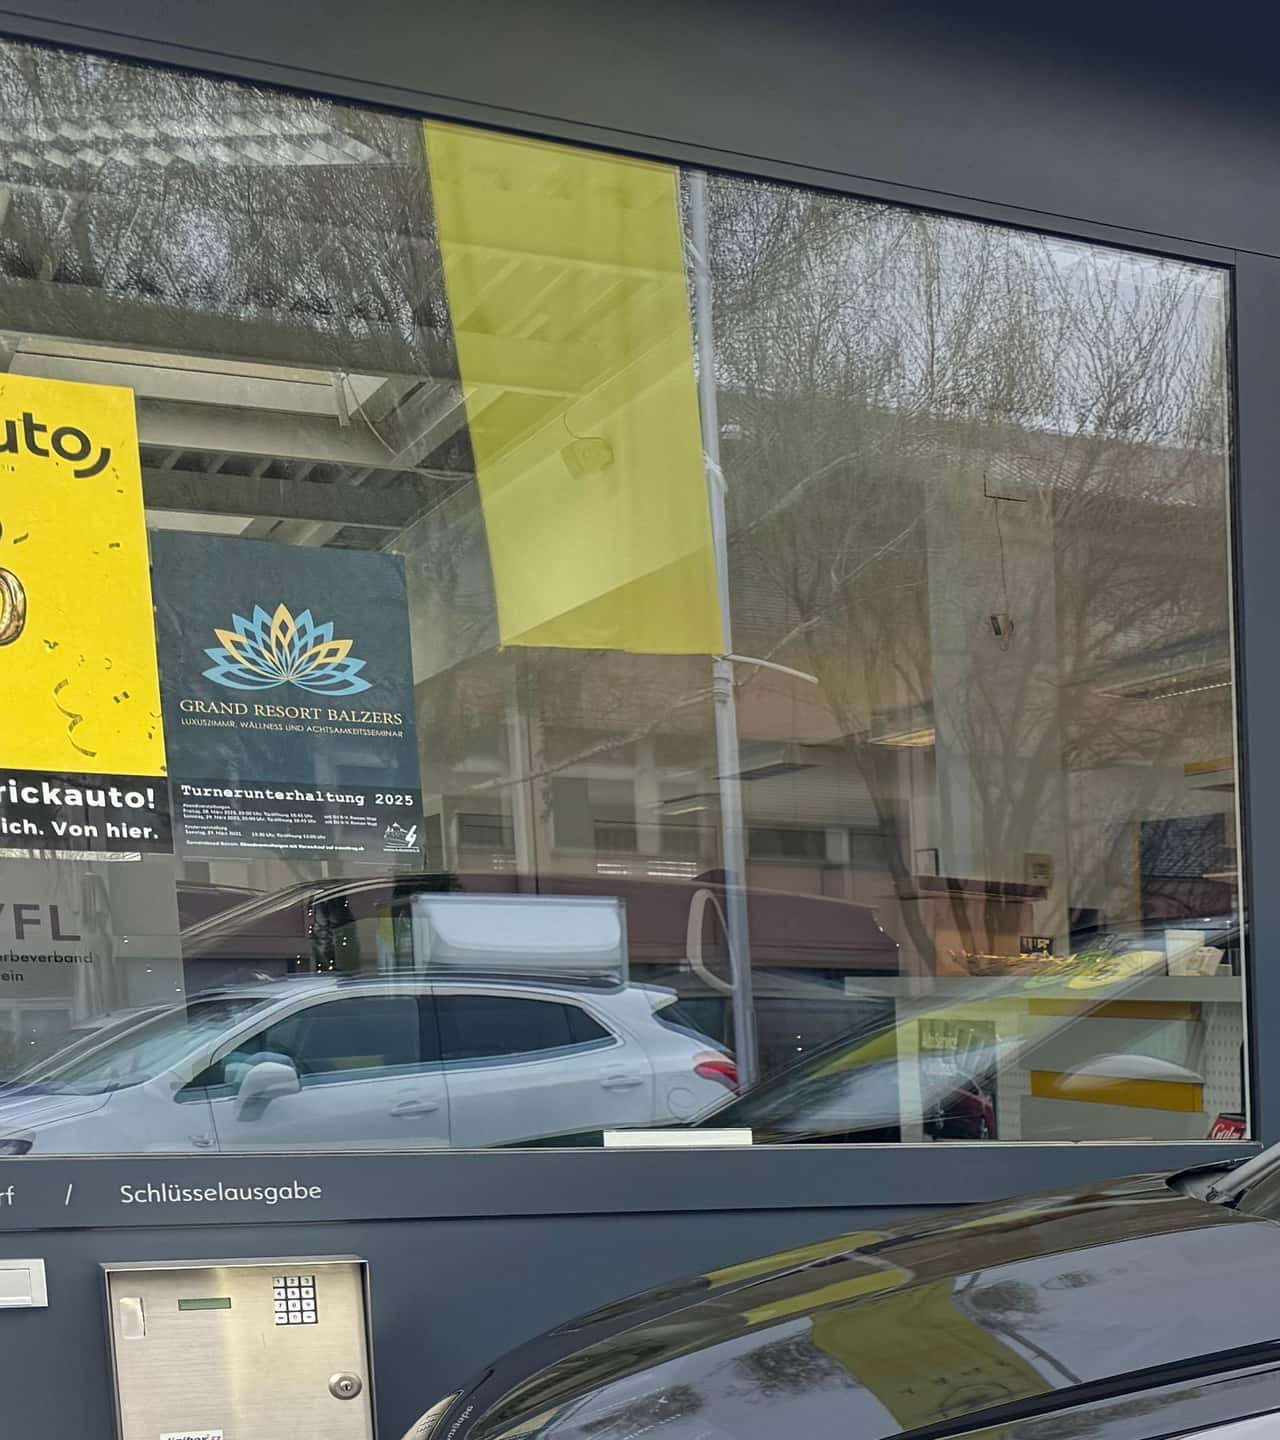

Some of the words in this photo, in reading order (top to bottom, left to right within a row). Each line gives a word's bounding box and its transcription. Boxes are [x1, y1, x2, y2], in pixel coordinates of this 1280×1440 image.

[180, 700, 248, 715] GRAND
[254, 704, 321, 720] RESORT
[328, 709, 402, 725] BALZERS
[181, 785, 365, 806] Turnerunterhaltung
[375, 794, 413, 806] 2025
[51, 821, 98, 837] Von
[106, 822, 159, 839] hier.
[0, 904, 81, 941] FL
[120, 1180, 322, 1205] Schlüsselausgabe
